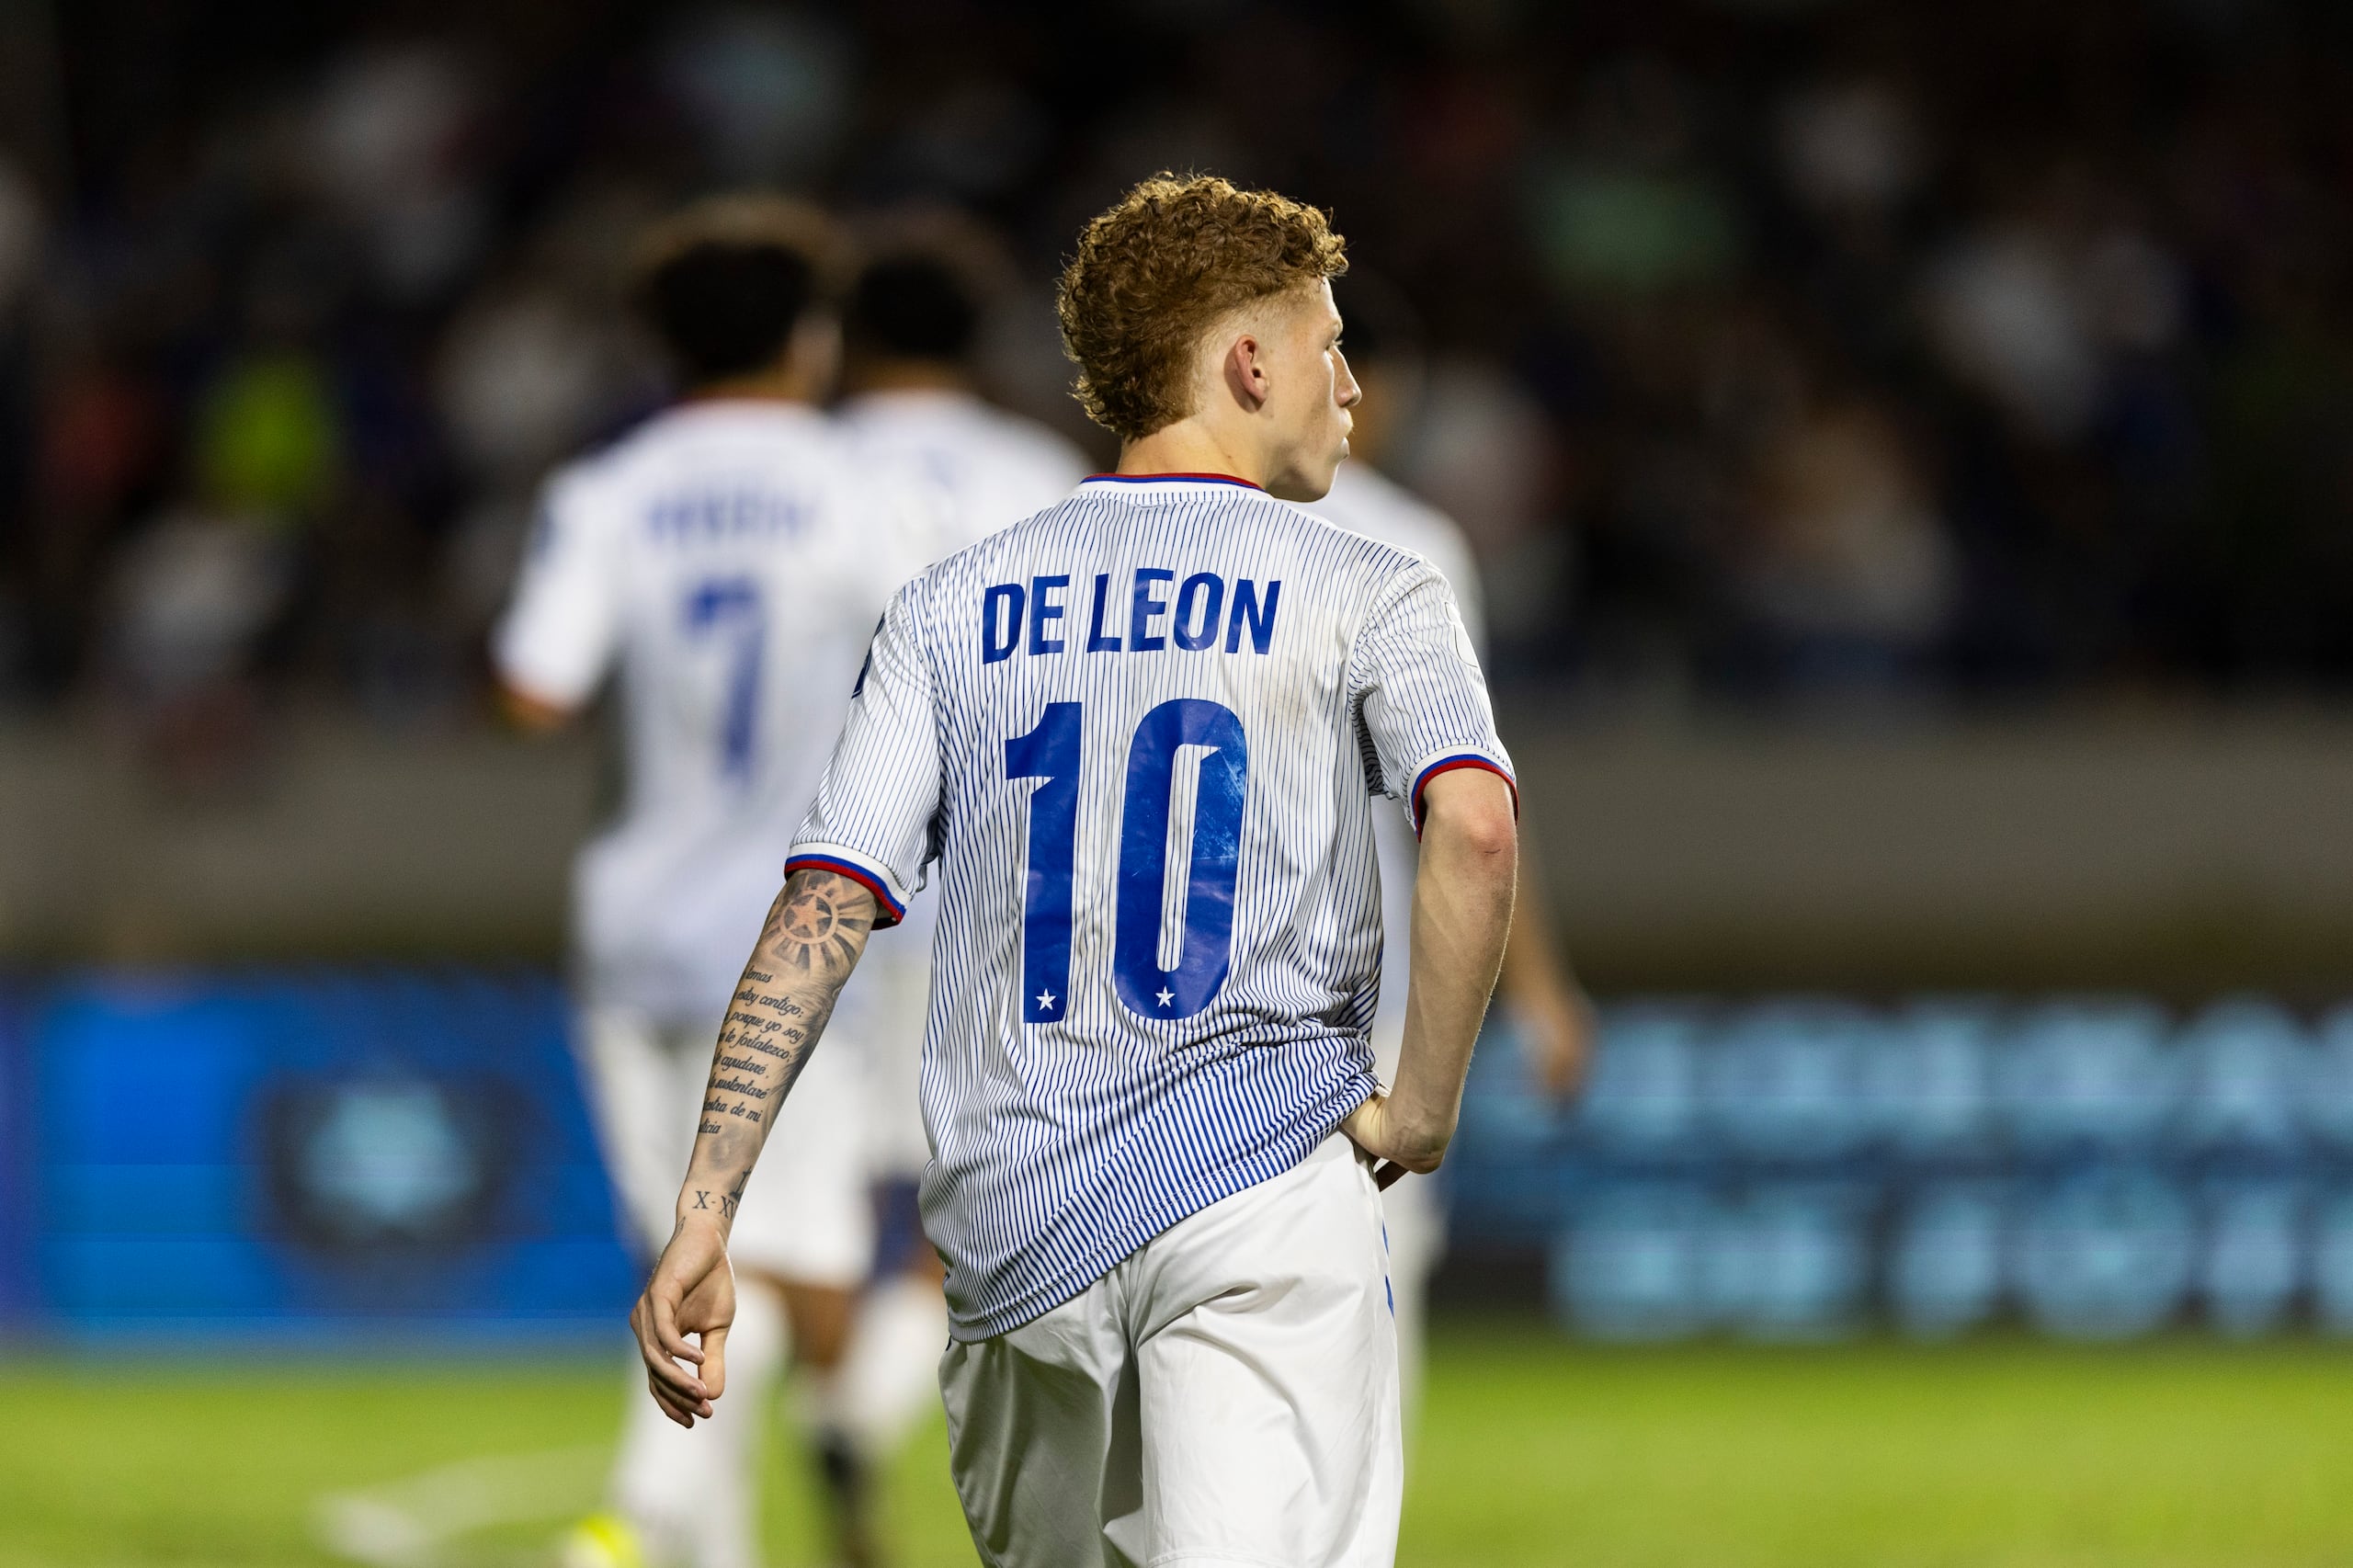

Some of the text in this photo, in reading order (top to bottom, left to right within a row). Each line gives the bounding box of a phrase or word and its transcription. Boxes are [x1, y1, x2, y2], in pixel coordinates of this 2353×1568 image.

[983, 568, 1281, 665] DE LEON
[683, 572, 767, 785] 7
[1005, 699, 1247, 1023] 10
[725, 1011, 804, 1044] porque yo soy
[730, 1101, 745, 1117] de
[745, 1109, 763, 1122] mi
